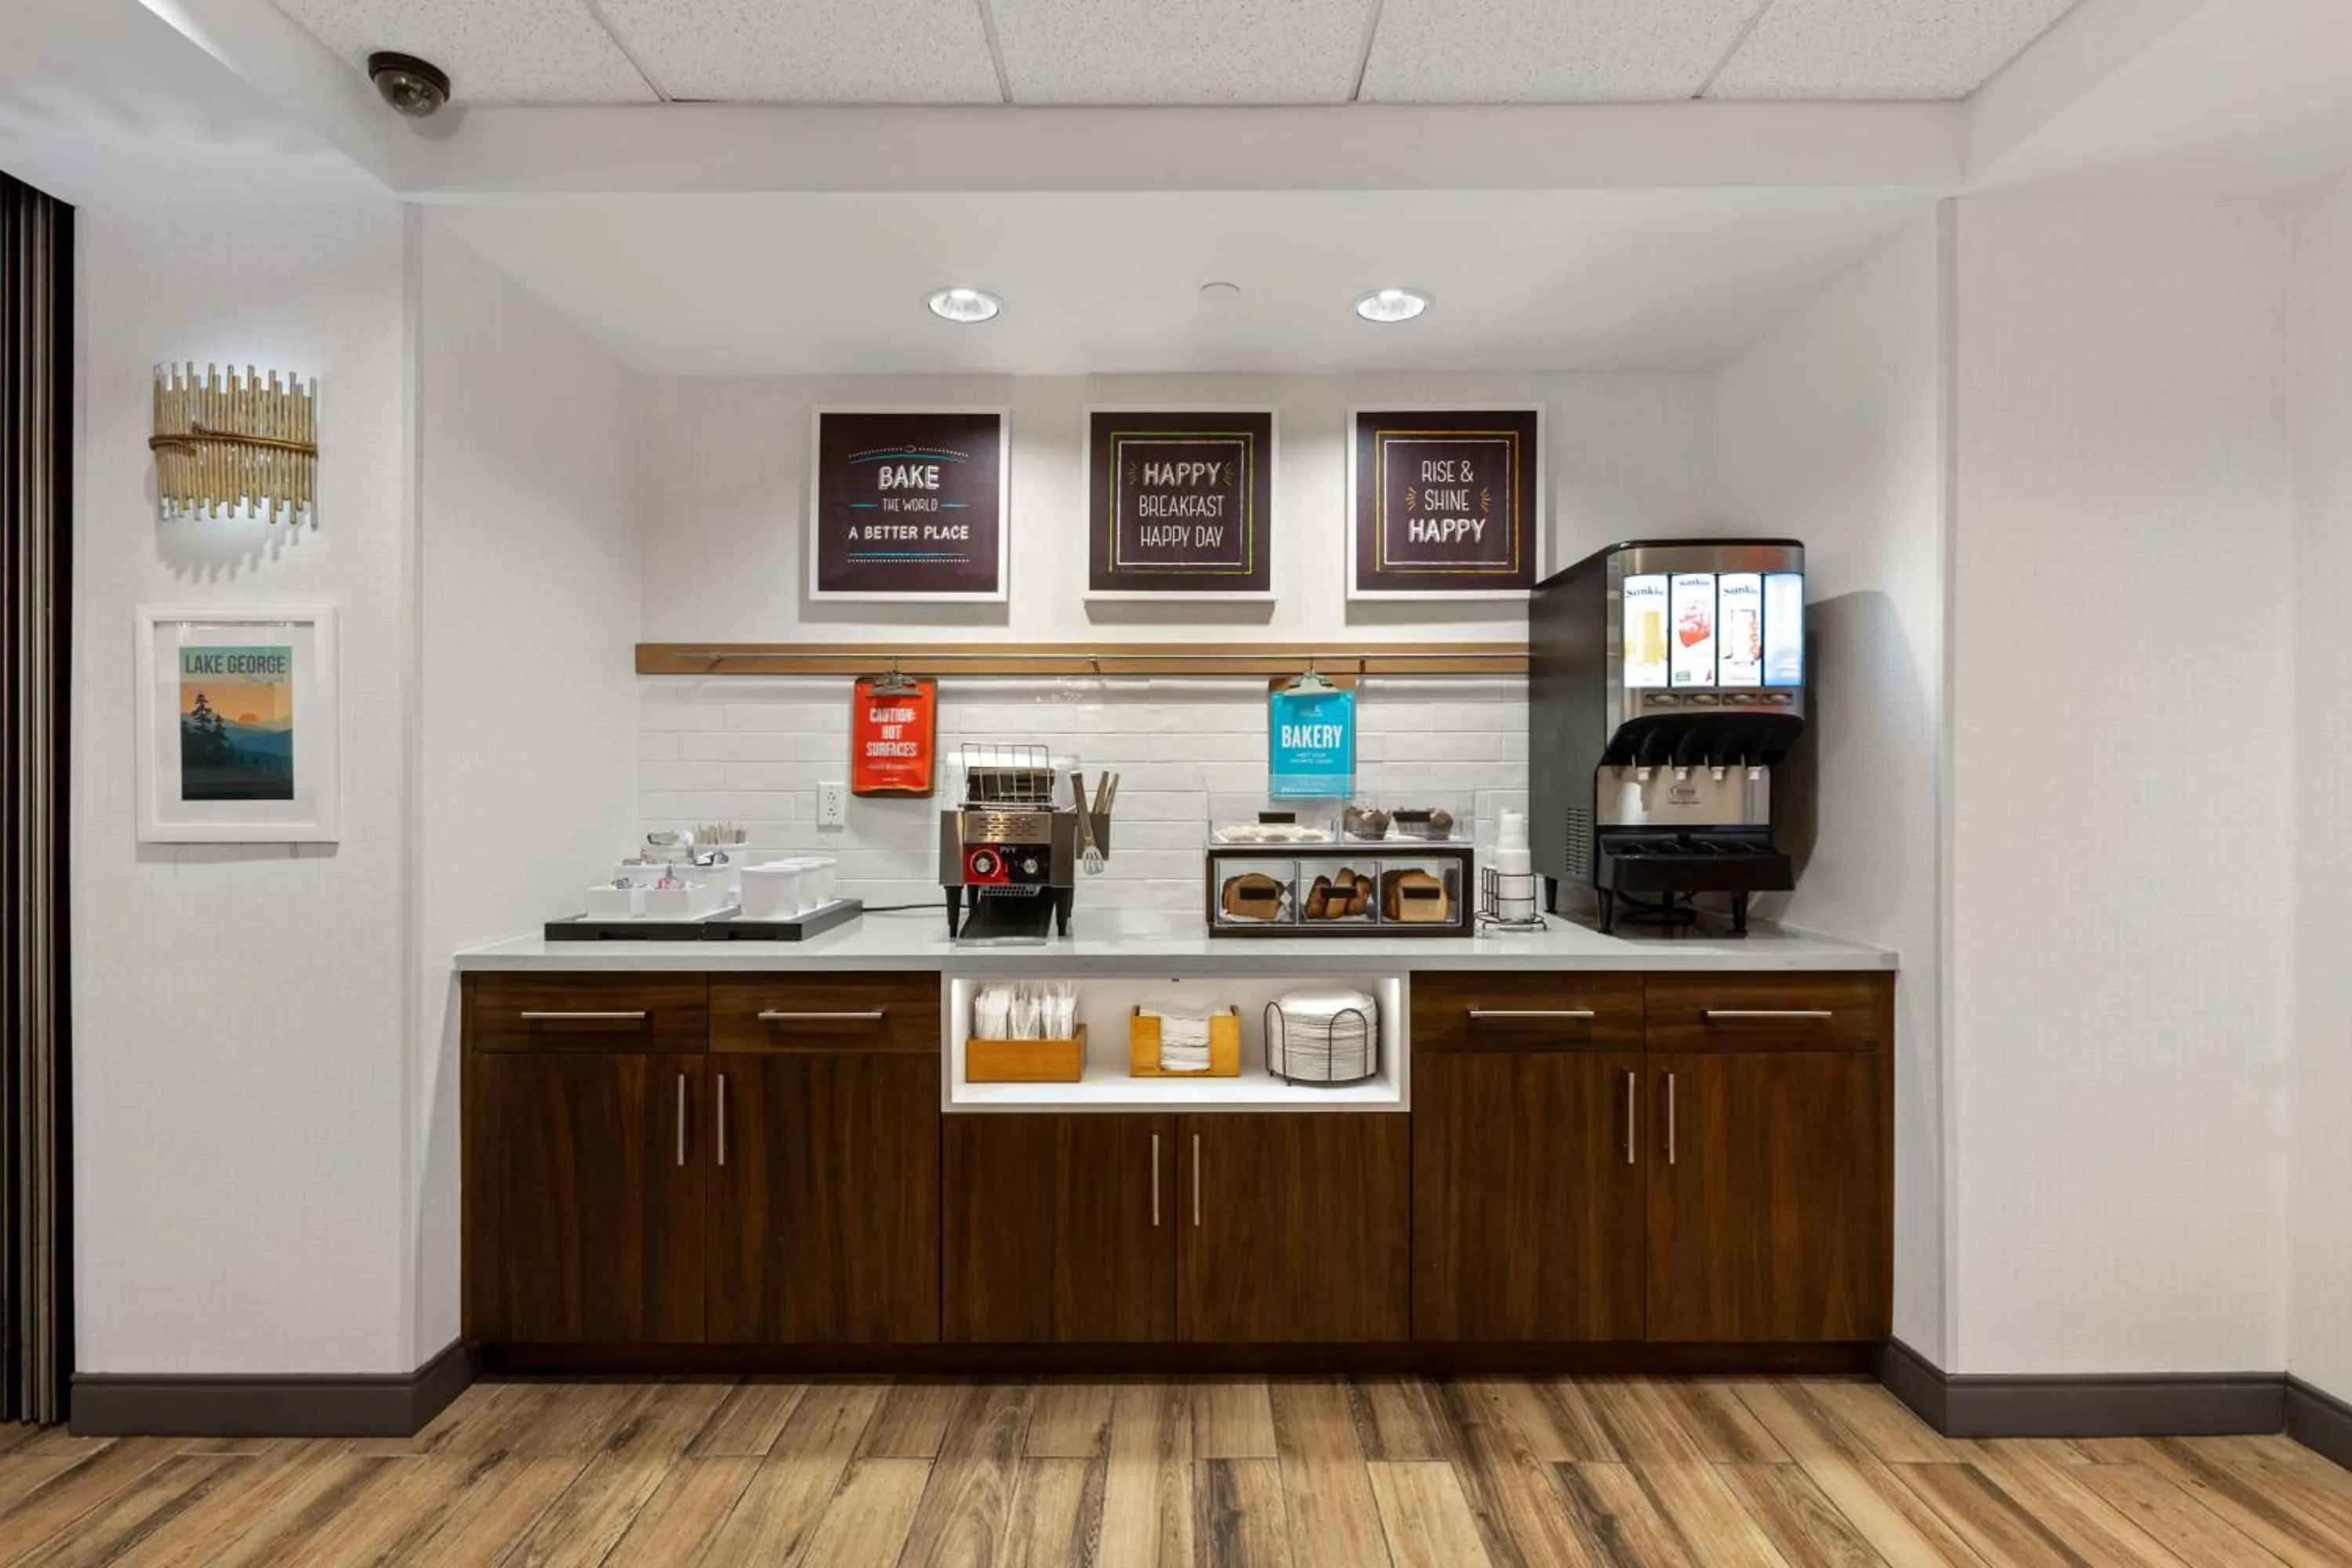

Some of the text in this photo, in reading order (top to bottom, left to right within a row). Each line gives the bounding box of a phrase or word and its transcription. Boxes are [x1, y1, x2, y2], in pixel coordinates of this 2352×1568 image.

[878, 464, 940, 490] BAKE
[1143, 462, 1221, 486] HAPPY
[1421, 460, 1473, 482] RISE &
[882, 498, 938, 512] THE WORLD
[1139, 495, 1225, 517] BREAKFAST
[1425, 488, 1470, 511] SHINE
[848, 525, 969, 540] A BETTER PLACE
[1141, 526, 1224, 548] HAPPY DAY
[1408, 518, 1486, 543] HAPPY
[186, 655, 286, 673] LAKE GEORGE
[881, 725, 902, 739] HOT
[1281, 724, 1343, 749] BAKERY
[866, 742, 917, 757] SURFACES
